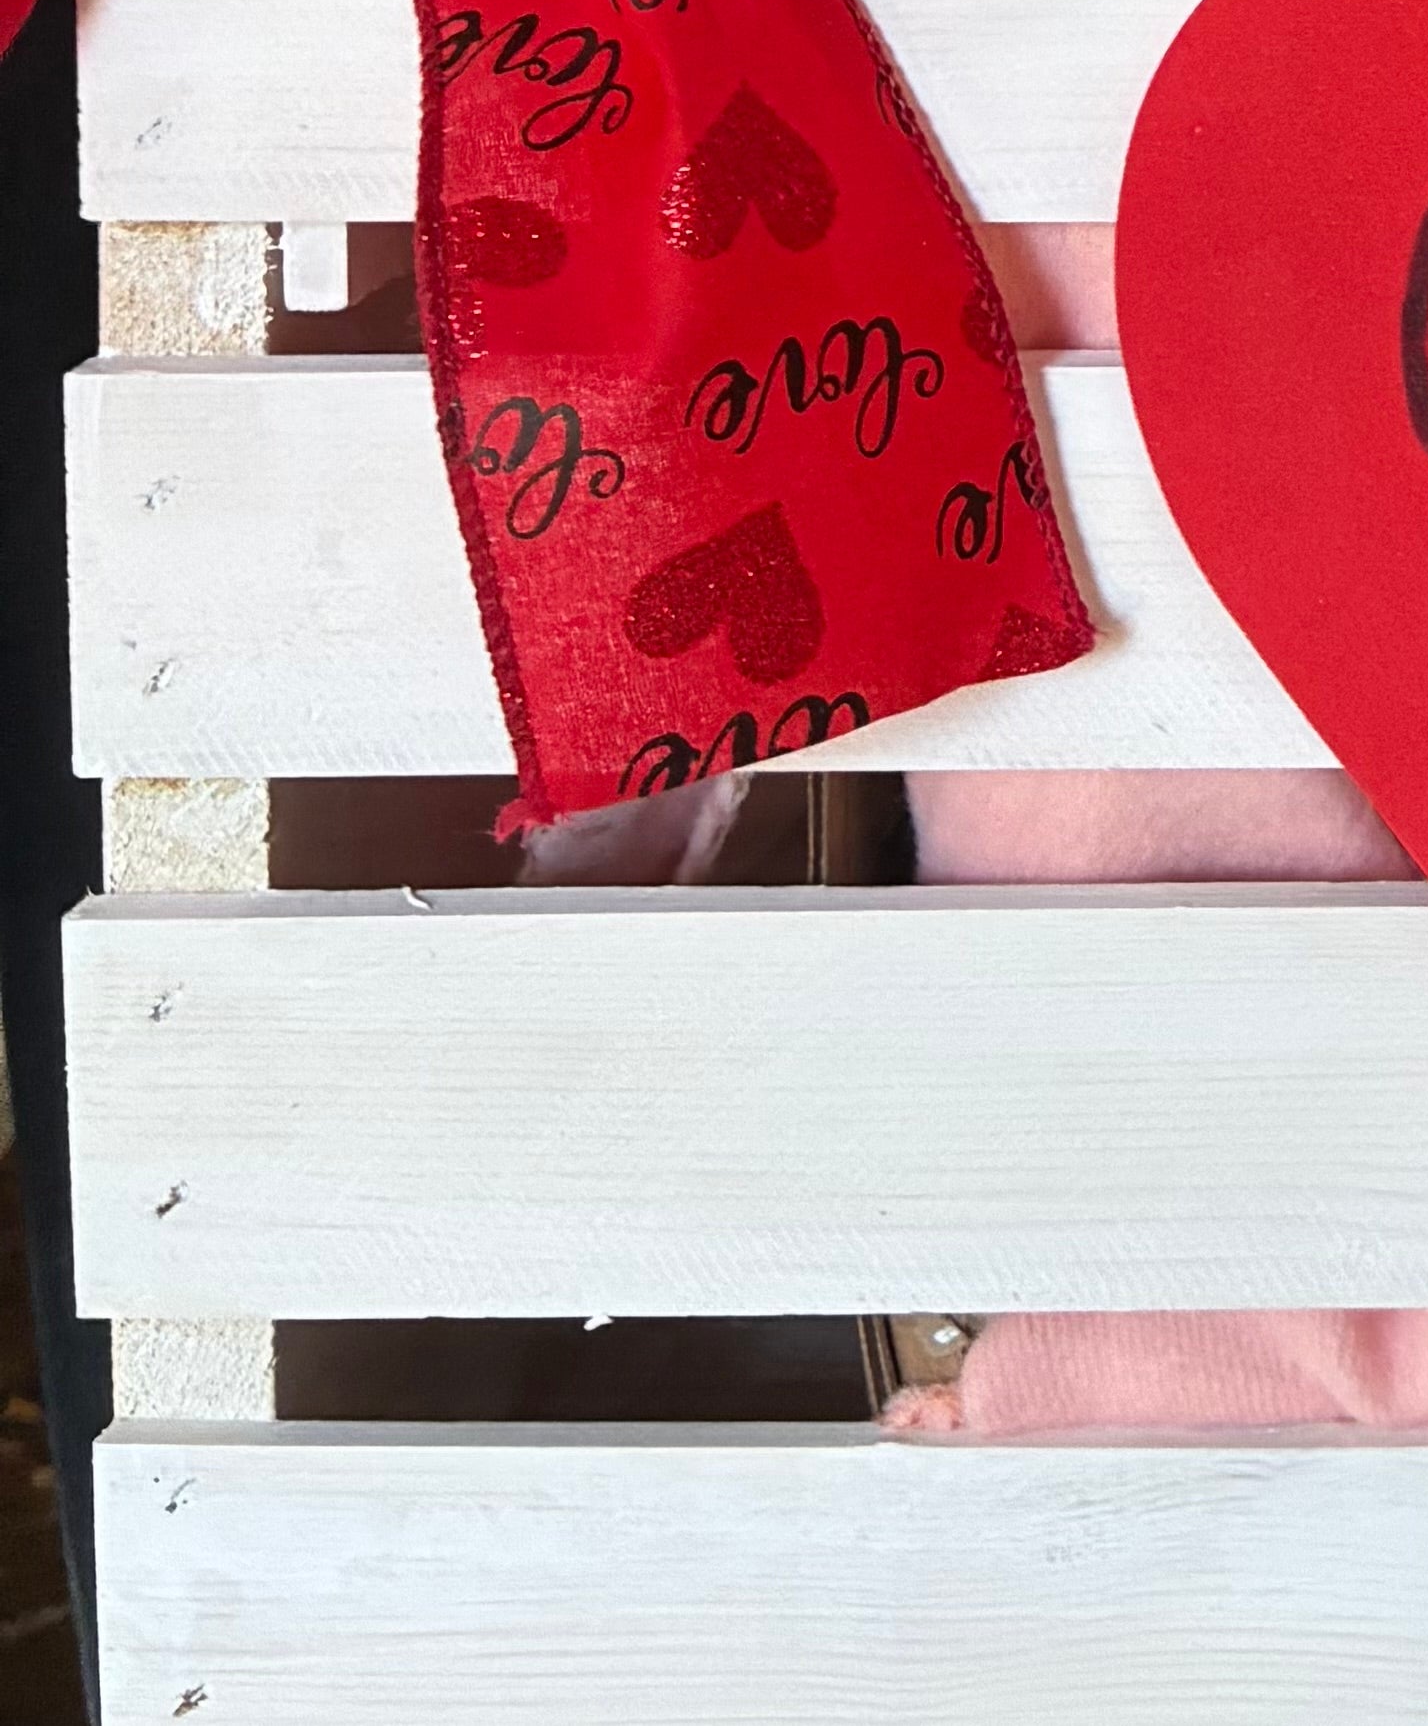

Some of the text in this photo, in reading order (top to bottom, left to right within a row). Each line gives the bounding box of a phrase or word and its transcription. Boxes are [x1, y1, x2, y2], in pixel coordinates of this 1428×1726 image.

[435, 9, 634, 151] love
[685, 315, 945, 459] love
[470, 396, 626, 540] lo
